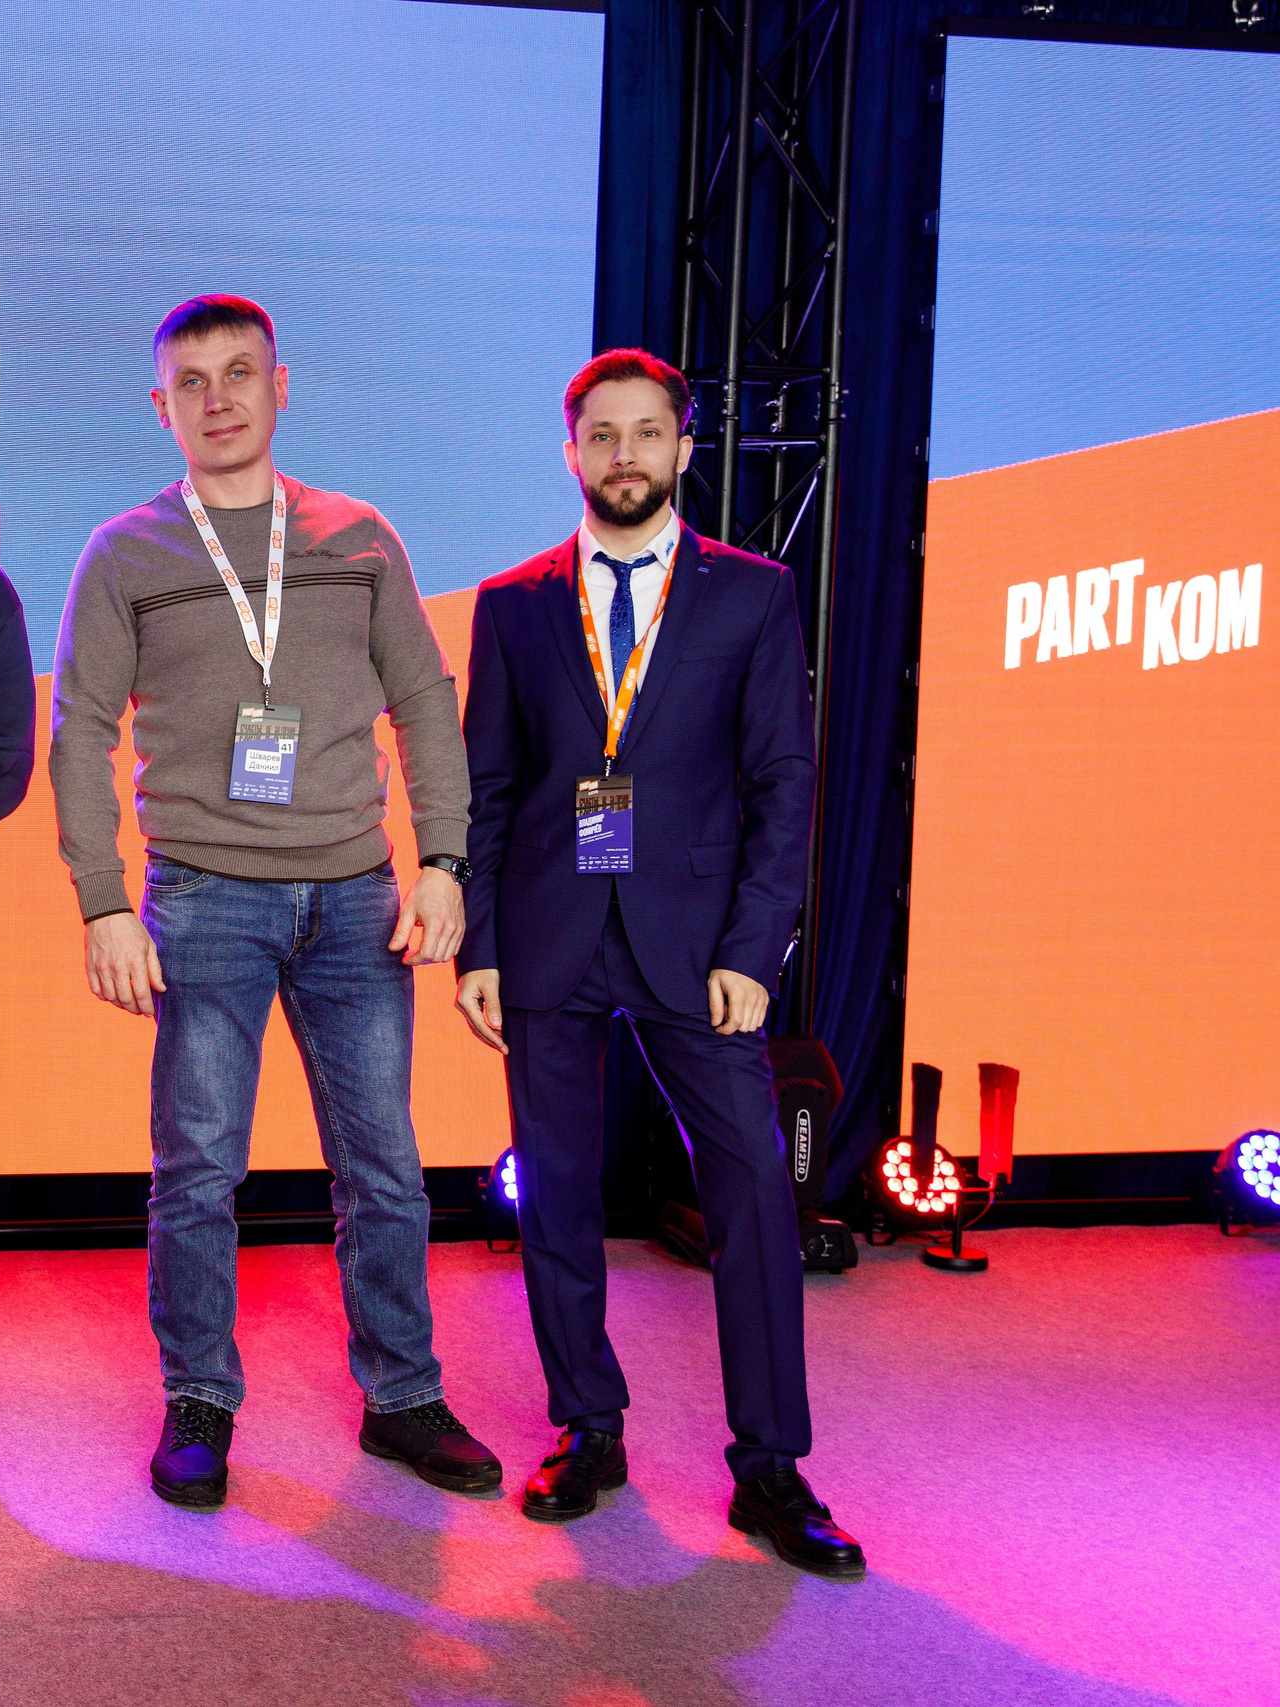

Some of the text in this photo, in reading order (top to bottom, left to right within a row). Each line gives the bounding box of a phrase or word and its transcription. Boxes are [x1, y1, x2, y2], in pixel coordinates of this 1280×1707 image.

[1004, 558, 1262, 670] PART KOM
[281, 744, 292, 752] 41
[250, 752, 280, 762] Шварев
[249, 761, 279, 771] Даниил
[798, 1118, 807, 1174] BEAM230
